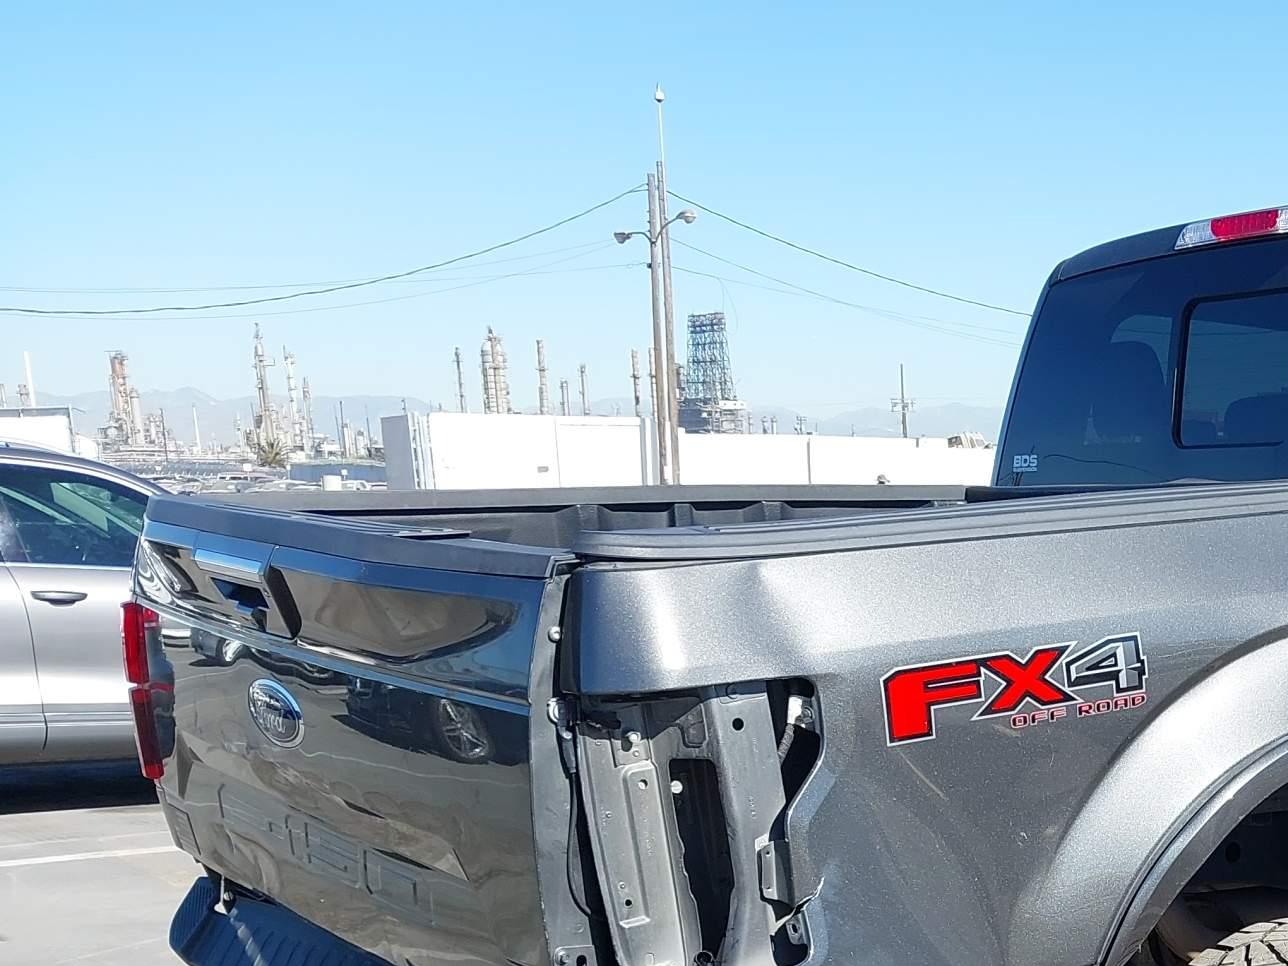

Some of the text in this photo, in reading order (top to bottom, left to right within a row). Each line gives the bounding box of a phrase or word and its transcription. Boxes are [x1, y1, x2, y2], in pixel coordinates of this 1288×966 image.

[1013, 454, 1038, 467] BDS
[880, 631, 1148, 747] FX4
[1010, 694, 1147, 729] OFF ROAD
